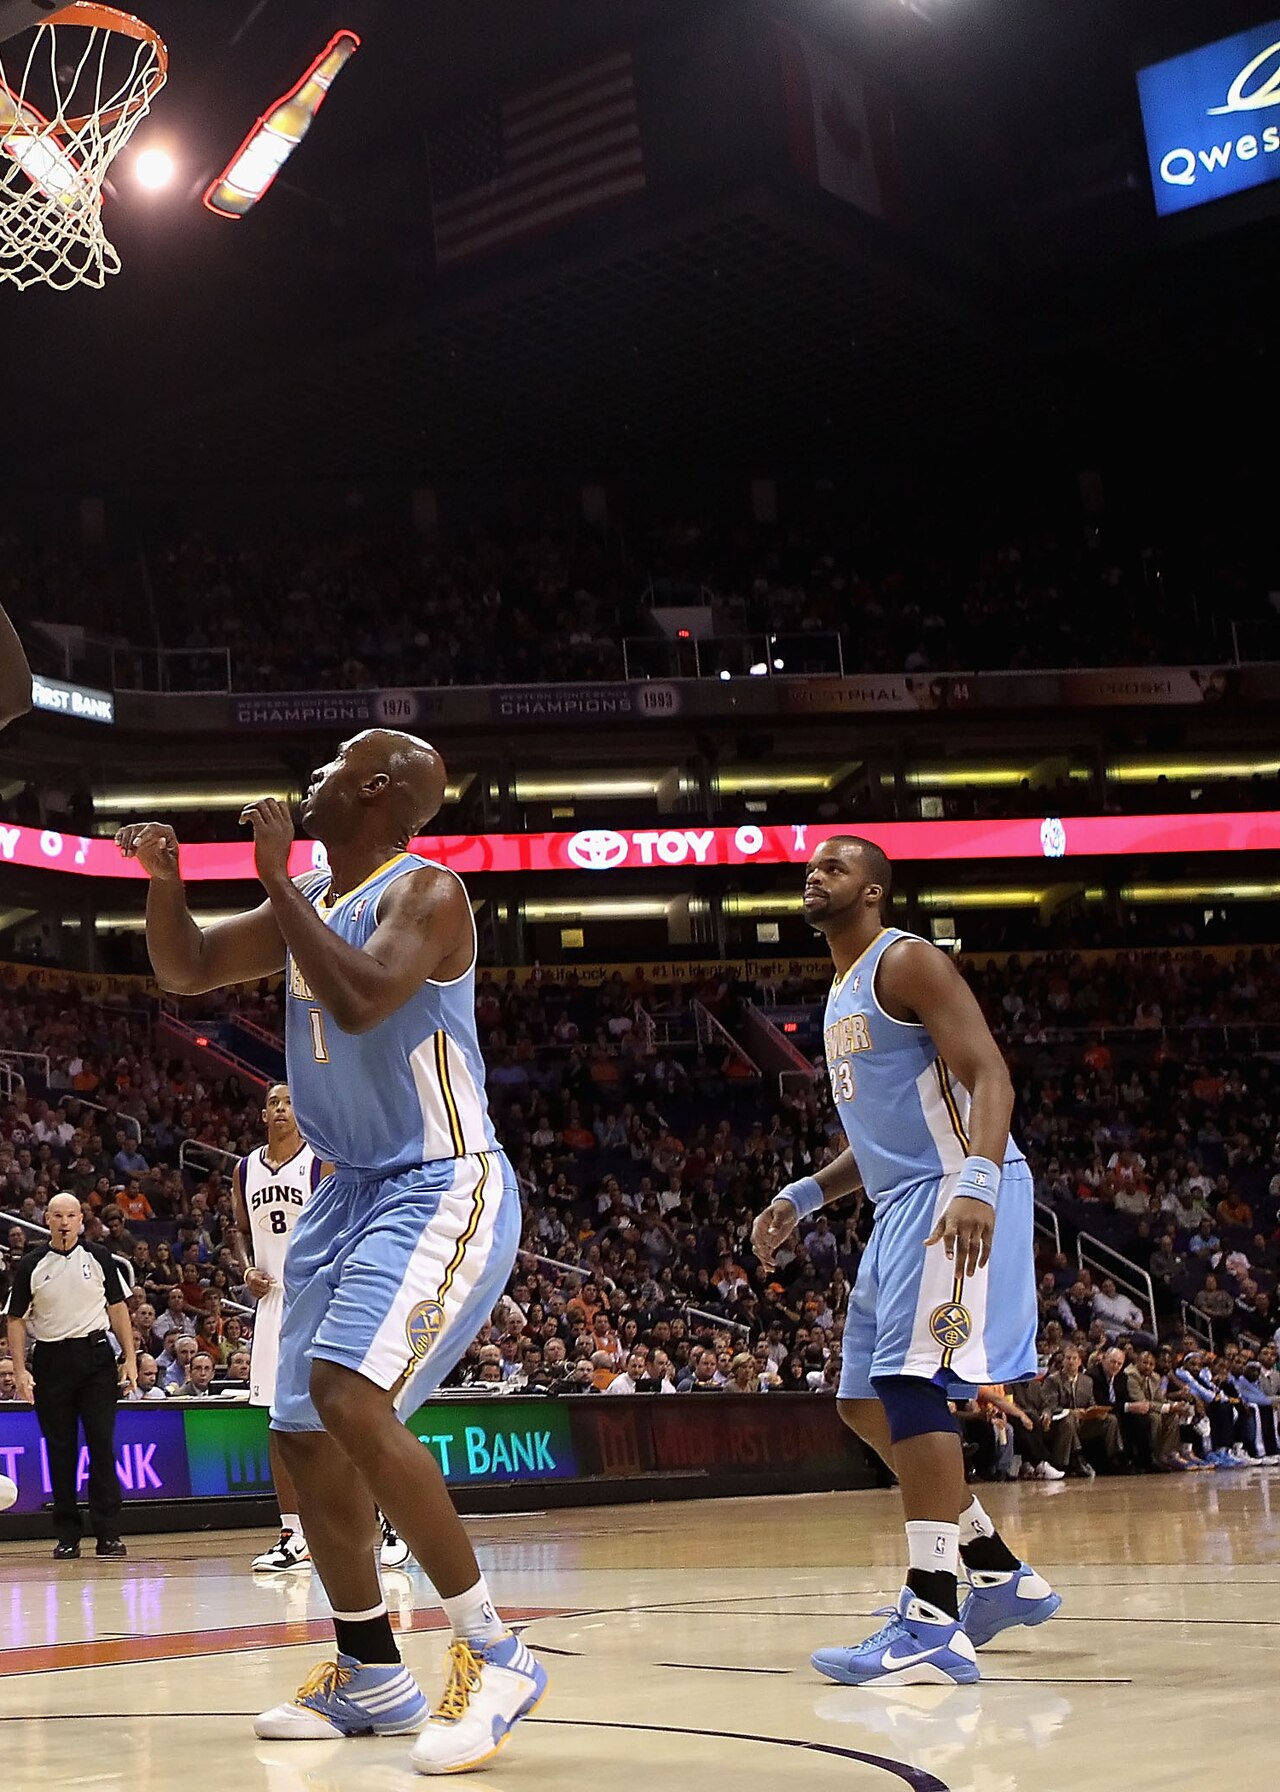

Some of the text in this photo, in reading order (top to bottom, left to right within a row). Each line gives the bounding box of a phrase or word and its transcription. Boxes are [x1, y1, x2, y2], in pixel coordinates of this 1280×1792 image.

[71, 692, 113, 719] BANK
[238, 705, 370, 723] CHAMPIONS
[500, 698, 632, 715] CHAMPIONS
[308, 1007, 329, 1063] 1
[251, 1184, 304, 1212] SUNS
[269, 1210, 288, 1235] 8
[465, 1426, 558, 1476] BANK
